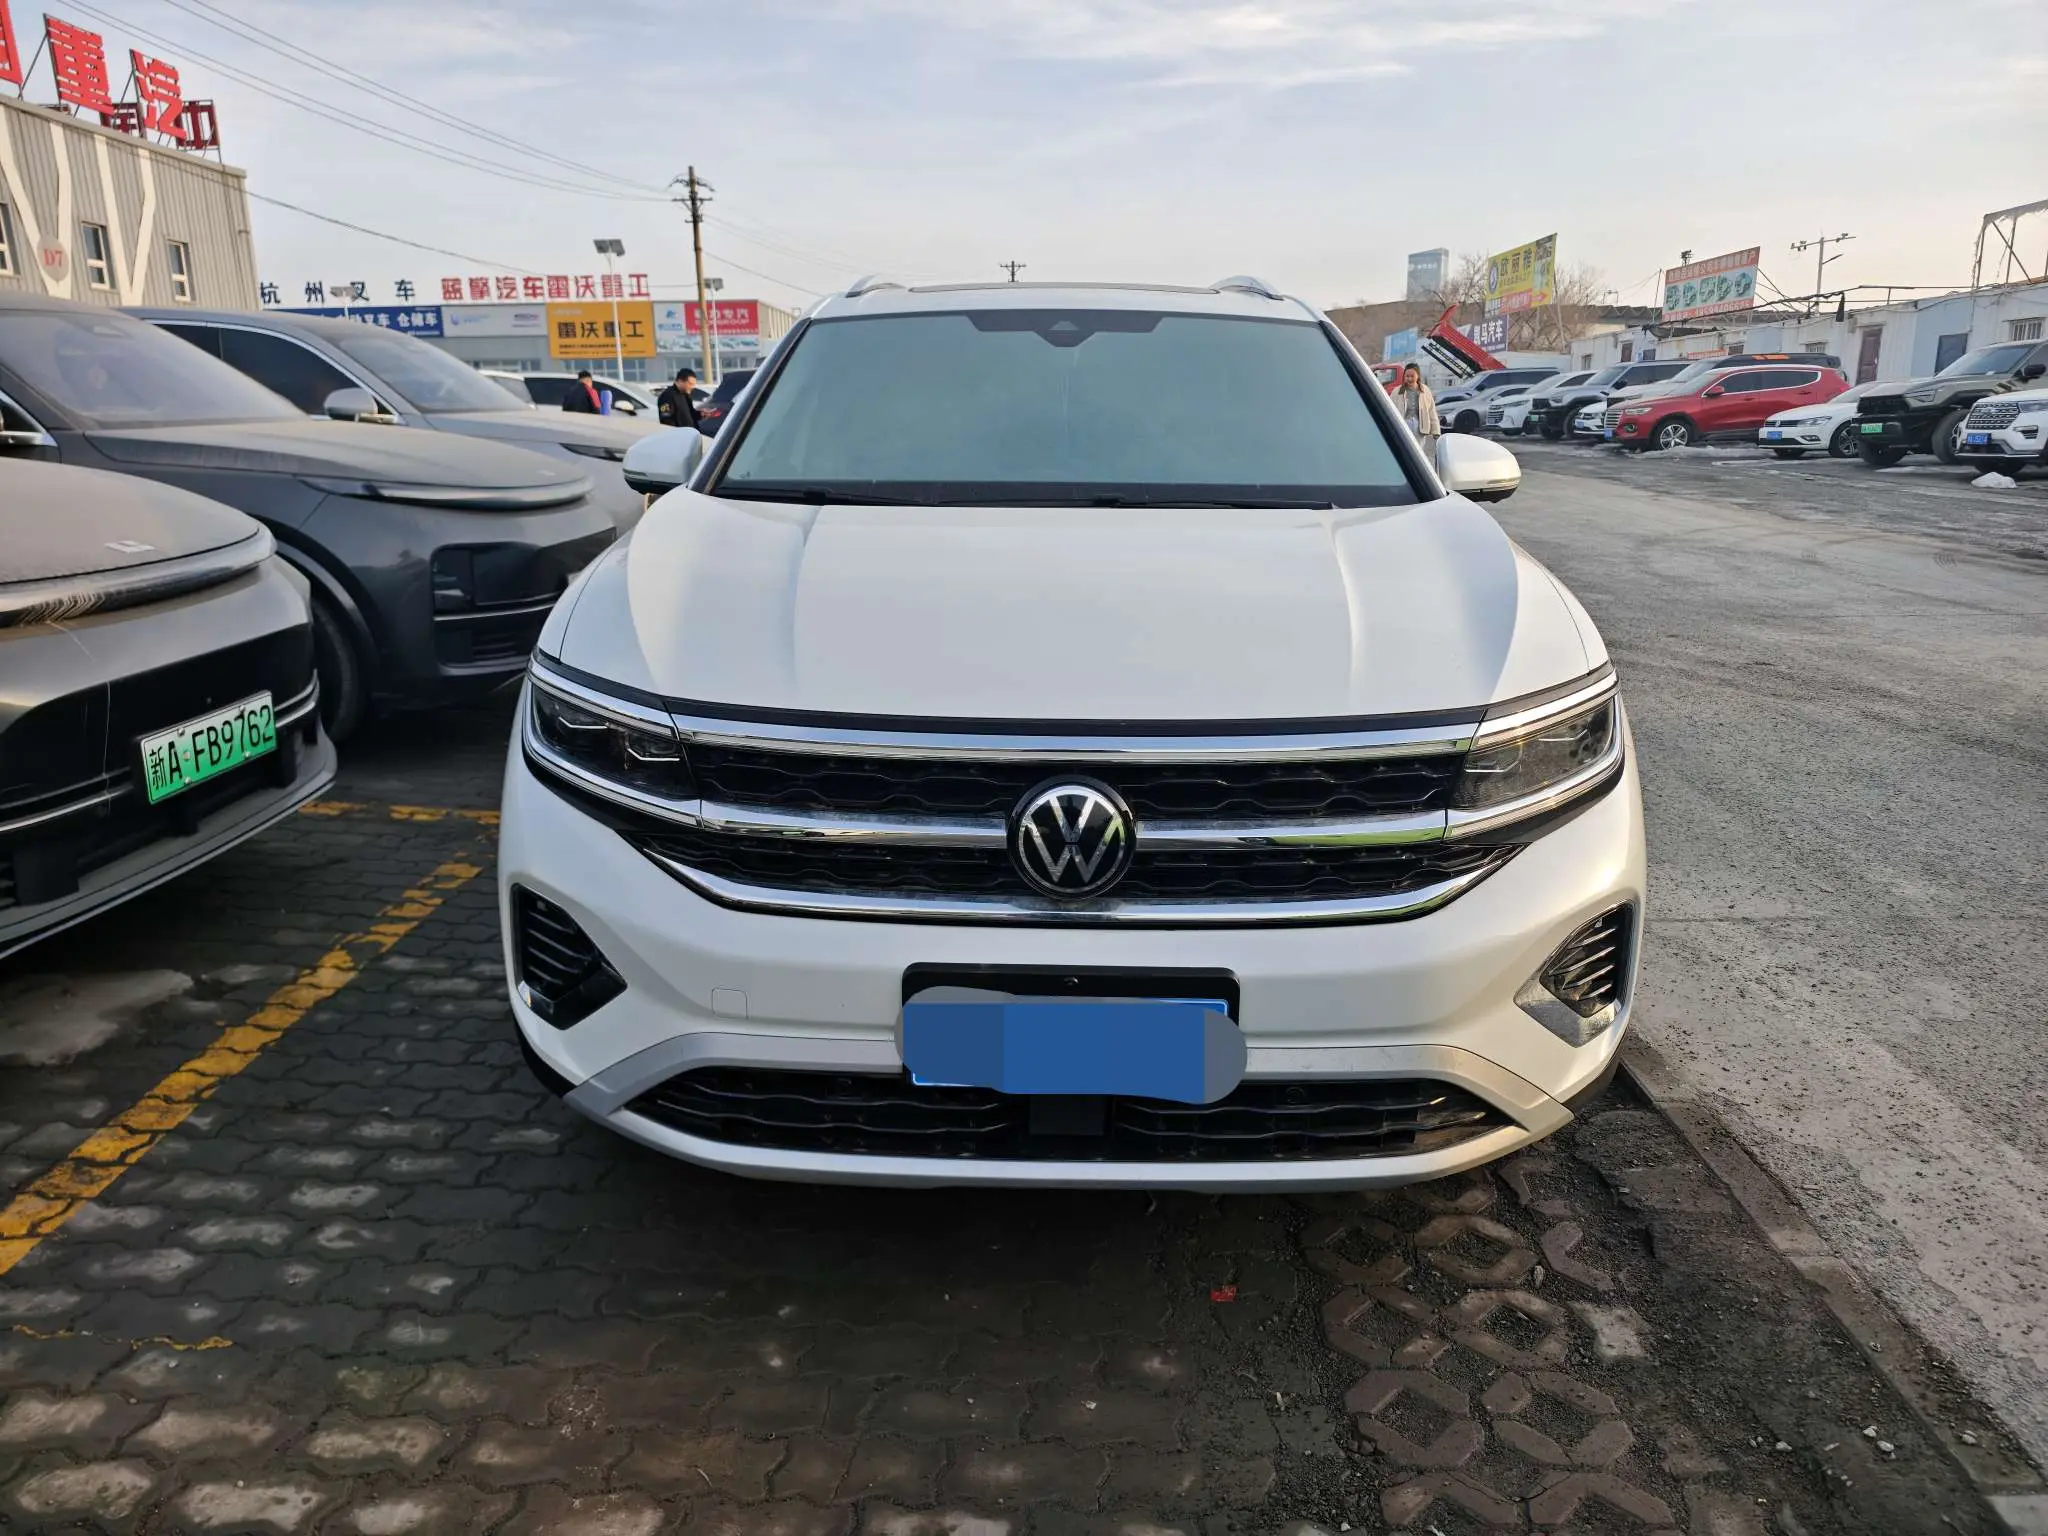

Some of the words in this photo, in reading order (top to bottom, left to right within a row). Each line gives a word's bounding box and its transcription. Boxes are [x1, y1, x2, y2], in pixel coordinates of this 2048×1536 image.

[43, 247, 64, 267] D7
[260, 279, 416, 304] 杭州叉车
